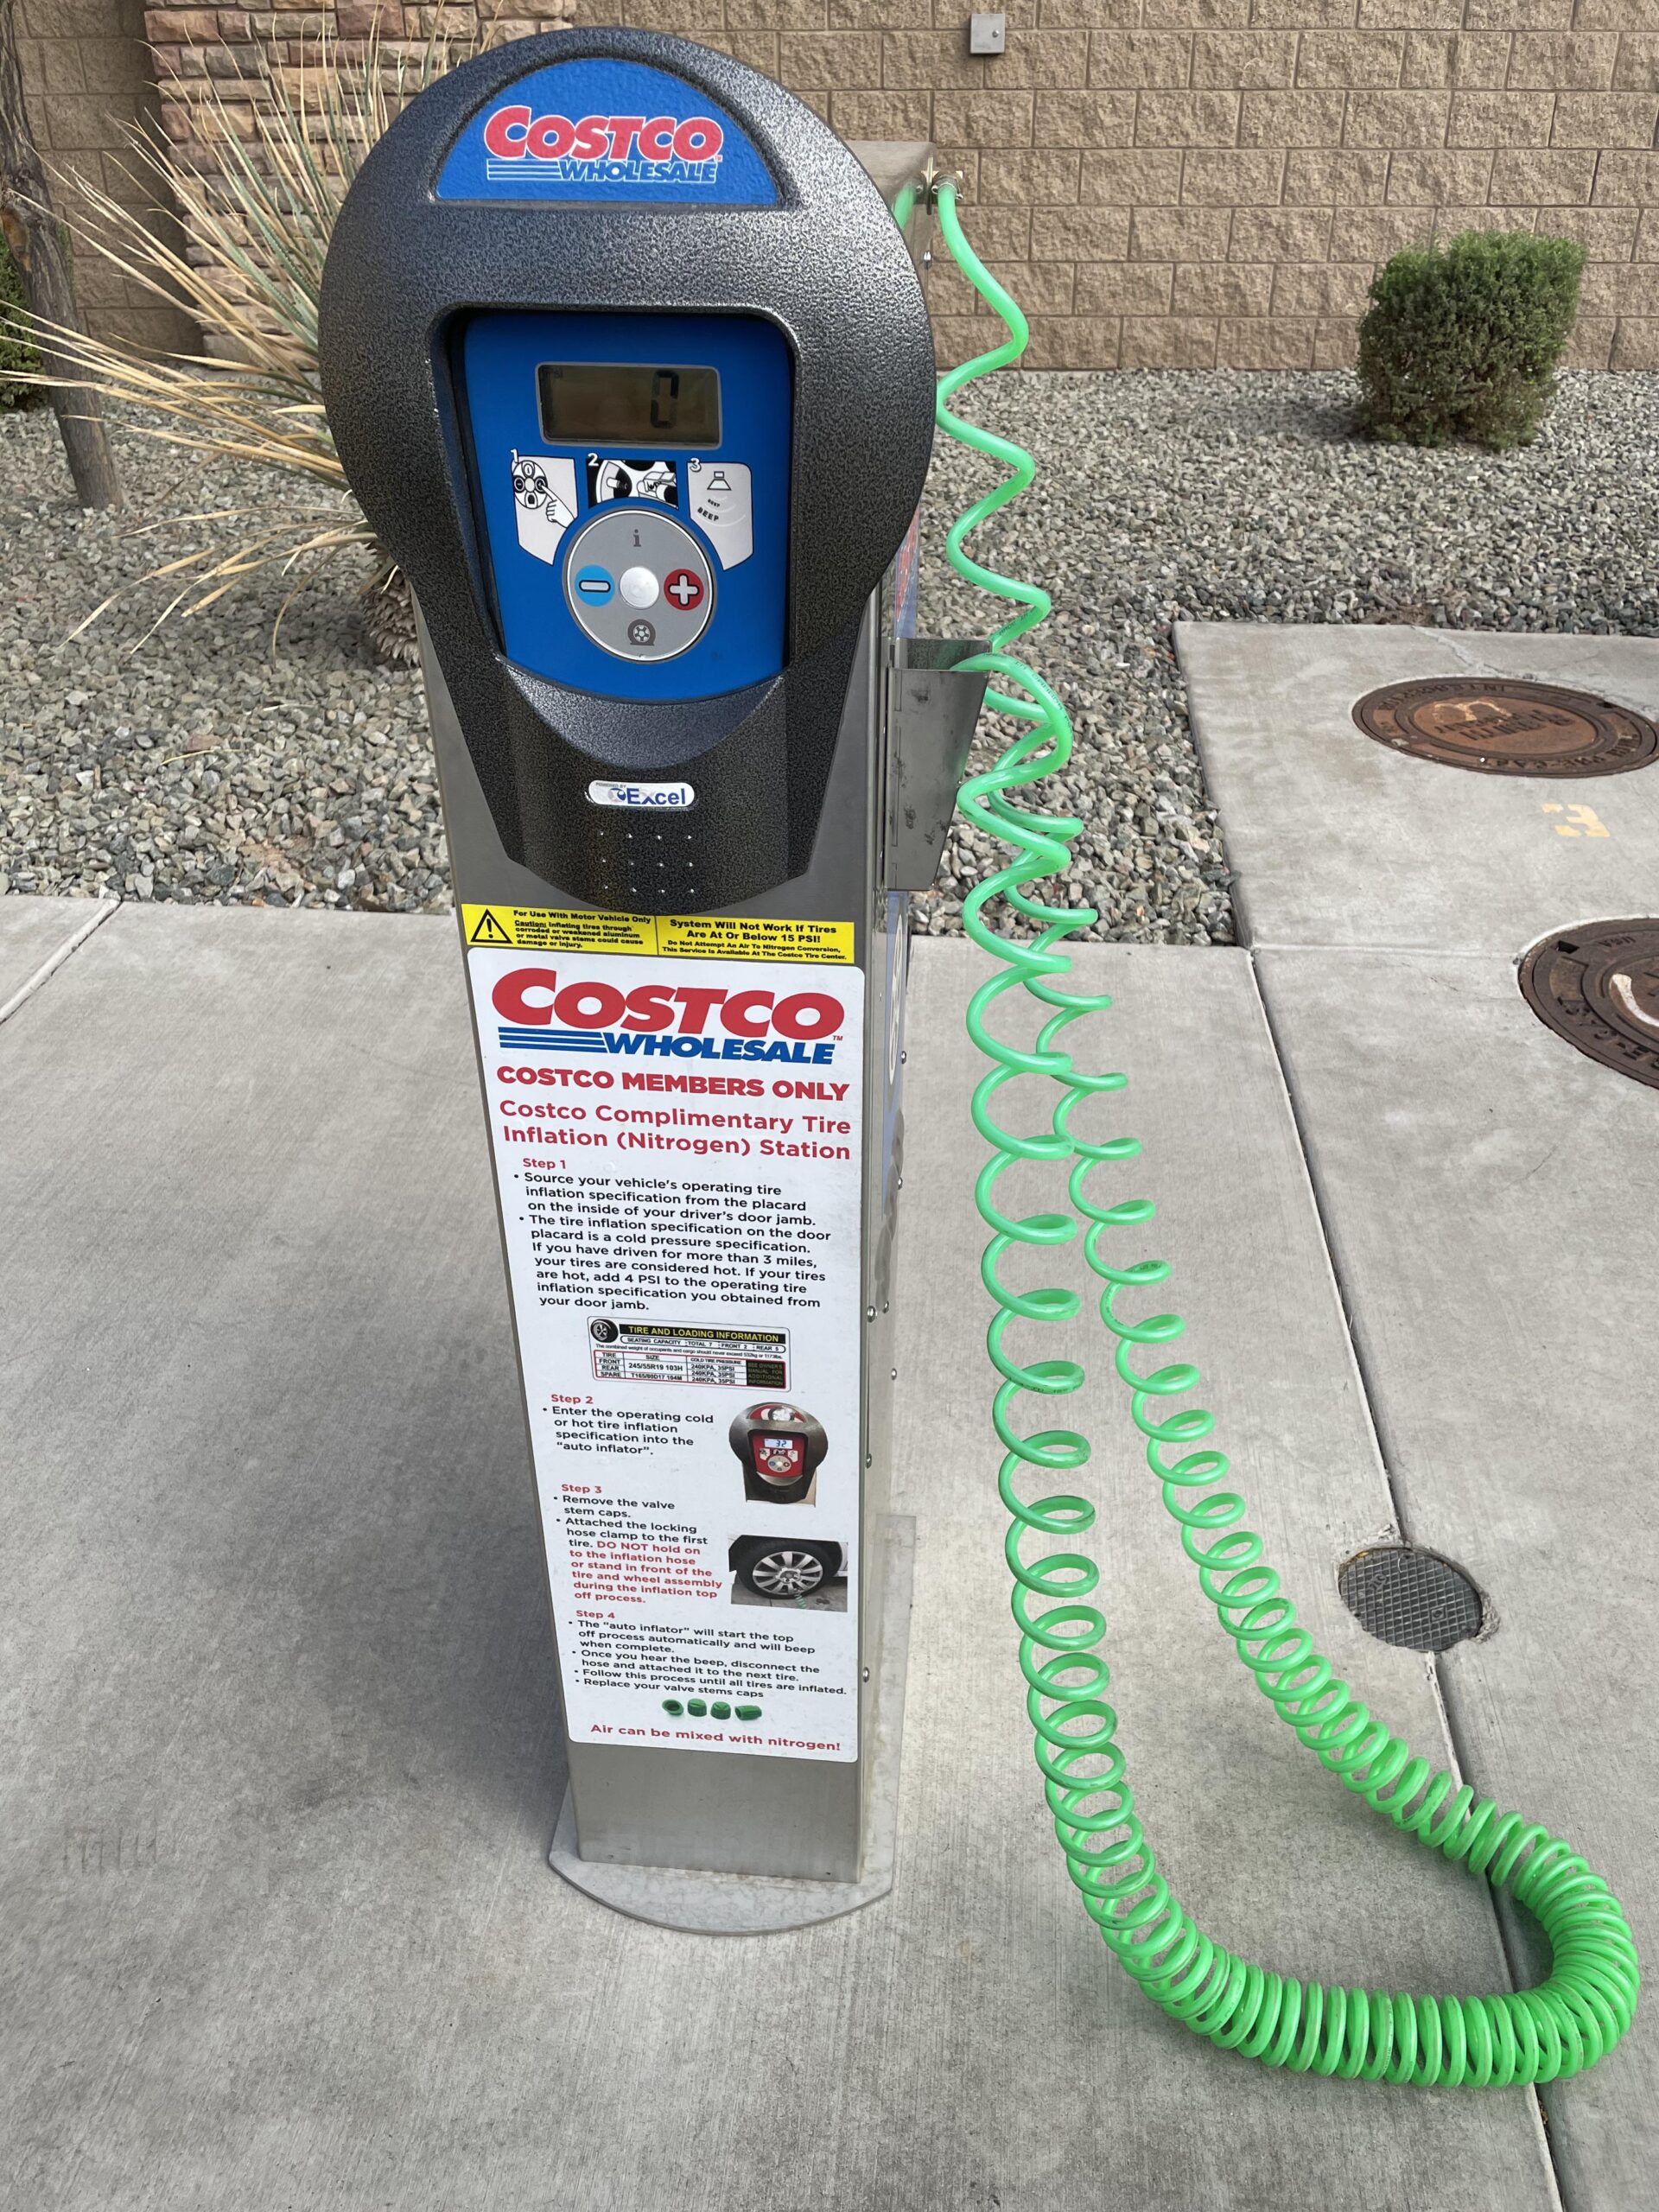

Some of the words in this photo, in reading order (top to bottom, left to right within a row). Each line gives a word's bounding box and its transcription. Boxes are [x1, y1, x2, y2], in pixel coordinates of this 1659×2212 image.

[485, 105, 723, 161] COSTCO
[557, 160, 718, 184] WHOLESALE
[651, 370, 679, 429] 0
[510, 448, 519, 463] 1
[588, 453, 599, 467] 2
[690, 457, 702, 473] 3
[697, 506, 720, 522] BEEP
[627, 788, 685, 804] Excel
[632, 916, 651, 925] Only
[670, 918, 711, 929] System
[687, 930, 706, 938] Are
[742, 932, 778, 941] Below
[493, 968, 844, 1040] COSTCO
[602, 1033, 834, 1065] WHOLESALE
[498, 1066, 614, 1089] COSTCO
[622, 1072, 764, 1096] MEMBERS
[772, 1080, 848, 1101] ONLY
[499, 1099, 587, 1120] Costco
[595, 1105, 793, 1135] Complimentary
[803, 1116, 851, 1135] Tire
[504, 1126, 607, 1146] Inflation
[617, 1132, 751, 1156] (Nitrogen)
[760, 1139, 850, 1160] Station
[523, 1158, 556, 1170] Step
[524, 1173, 574, 1184] Source
[578, 1177, 611, 1186] your
[682, 1183, 752, 1195] operating
[757, 1185, 781, 1195] tire
[526, 1186, 584, 1198] inflation
[589, 1192, 681, 1204] specification
[685, 1195, 719, 1206] from
[724, 1197, 747, 1207] the
[753, 1198, 806, 1211] placard
[539, 1297, 570, 1306] your
[575, 1297, 607, 1307] door
[611, 1299, 649, 1310] jamb.
[673, 1329, 714, 1338] LOADING
[716, 1332, 779, 1342] INFORMATION
[551, 1395, 581, 1403] Step
[552, 1406, 588, 1415] Enter
[591, 1408, 613, 1417] the
[617, 1411, 681, 1422] operating
[685, 1414, 714, 1423] cold
[572, 1419, 594, 1428] hot
[597, 1421, 620, 1429] tire
[624, 1421, 677, 1433] inflation
[562, 1484, 589, 1493] Step
[563, 1495, 613, 1505] Remove
[617, 1498, 638, 1507] the
[641, 1501, 675, 1510] valve
[564, 1507, 594, 1516] stem
[598, 1510, 631, 1518] caps.
[565, 1517, 622, 1528] Attached
[626, 1521, 647, 1529] the
[651, 1522, 696, 1534] locking
[567, 1528, 596, 1537] hose
[600, 1530, 638, 1541] clamp
[658, 1534, 679, 1542] the
[683, 1535, 708, 1544] first
[569, 1539, 593, 1548] tire.
[620, 1542, 648, 1551] NOT
[652, 1544, 681, 1554] hold
[594, 1594, 645, 1604] process.
[576, 1610, 603, 1618] Step
[773, 1634, 794, 1643] top
[584, 1678, 630, 1688] Replace
[664, 1684, 695, 1693] valve
[698, 1687, 733, 1695] stems
[591, 1724, 613, 1732] Air
[650, 1728, 670, 1738] be
[676, 1732, 724, 1742] mixed
[729, 1736, 763, 1745] with
[767, 1738, 840, 1751] nitrogen!
